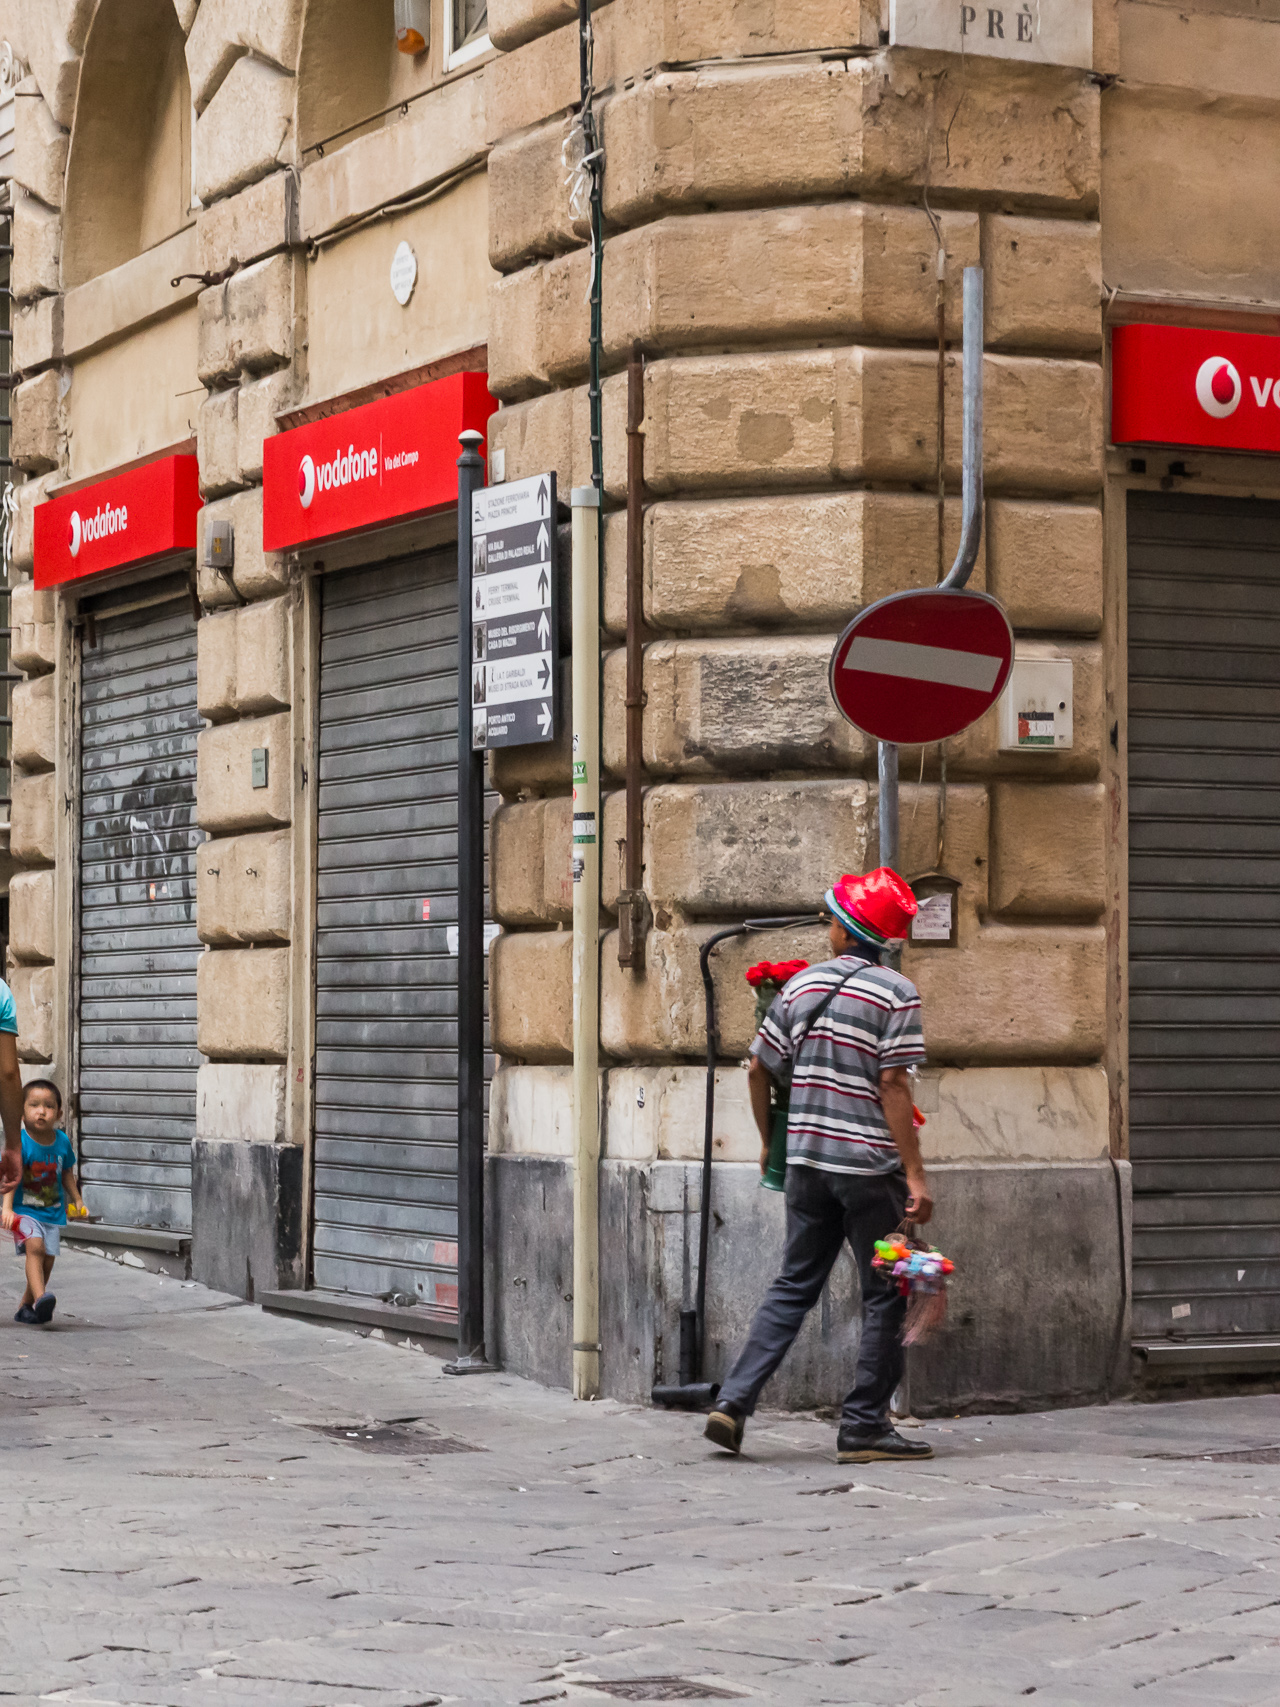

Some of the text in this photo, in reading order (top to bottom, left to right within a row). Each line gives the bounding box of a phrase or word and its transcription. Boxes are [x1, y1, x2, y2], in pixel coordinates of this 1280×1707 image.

[959, 3, 1033, 43] PRÈ
[317, 444, 378, 492] vodafone
[384, 451, 419, 471] Via del Campo
[82, 502, 128, 543] vodafone
[488, 581, 519, 595] FERRY TERMINAL
[488, 593, 520, 607] CRUISE TERMINAL
